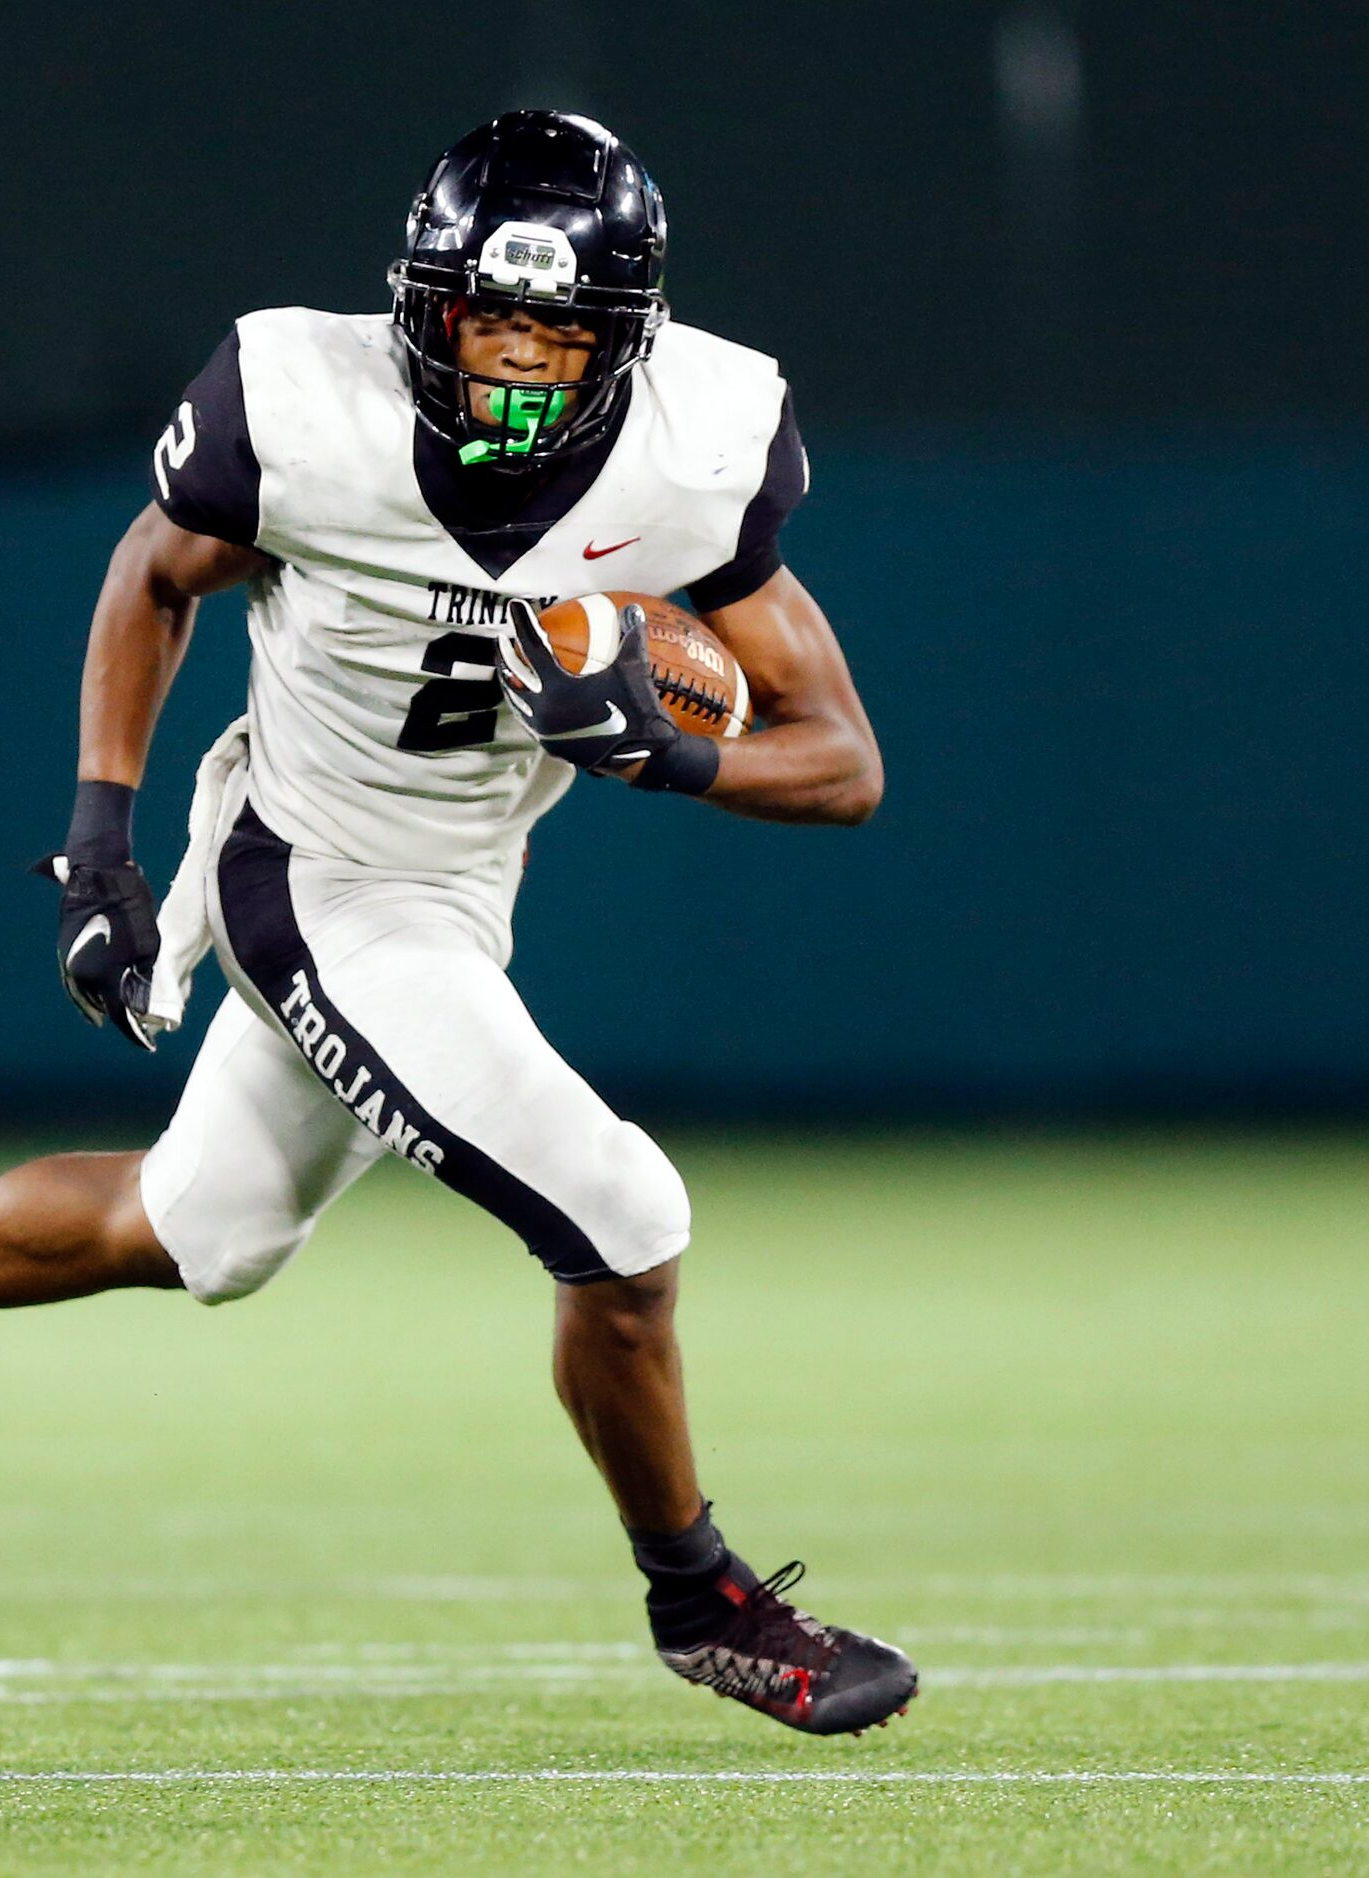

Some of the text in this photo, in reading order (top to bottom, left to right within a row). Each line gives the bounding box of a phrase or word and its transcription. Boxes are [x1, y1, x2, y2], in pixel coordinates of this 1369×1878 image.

[153, 400, 196, 500] 2
[399, 631, 508, 752] 2
[280, 968, 446, 1177] TROJANS
